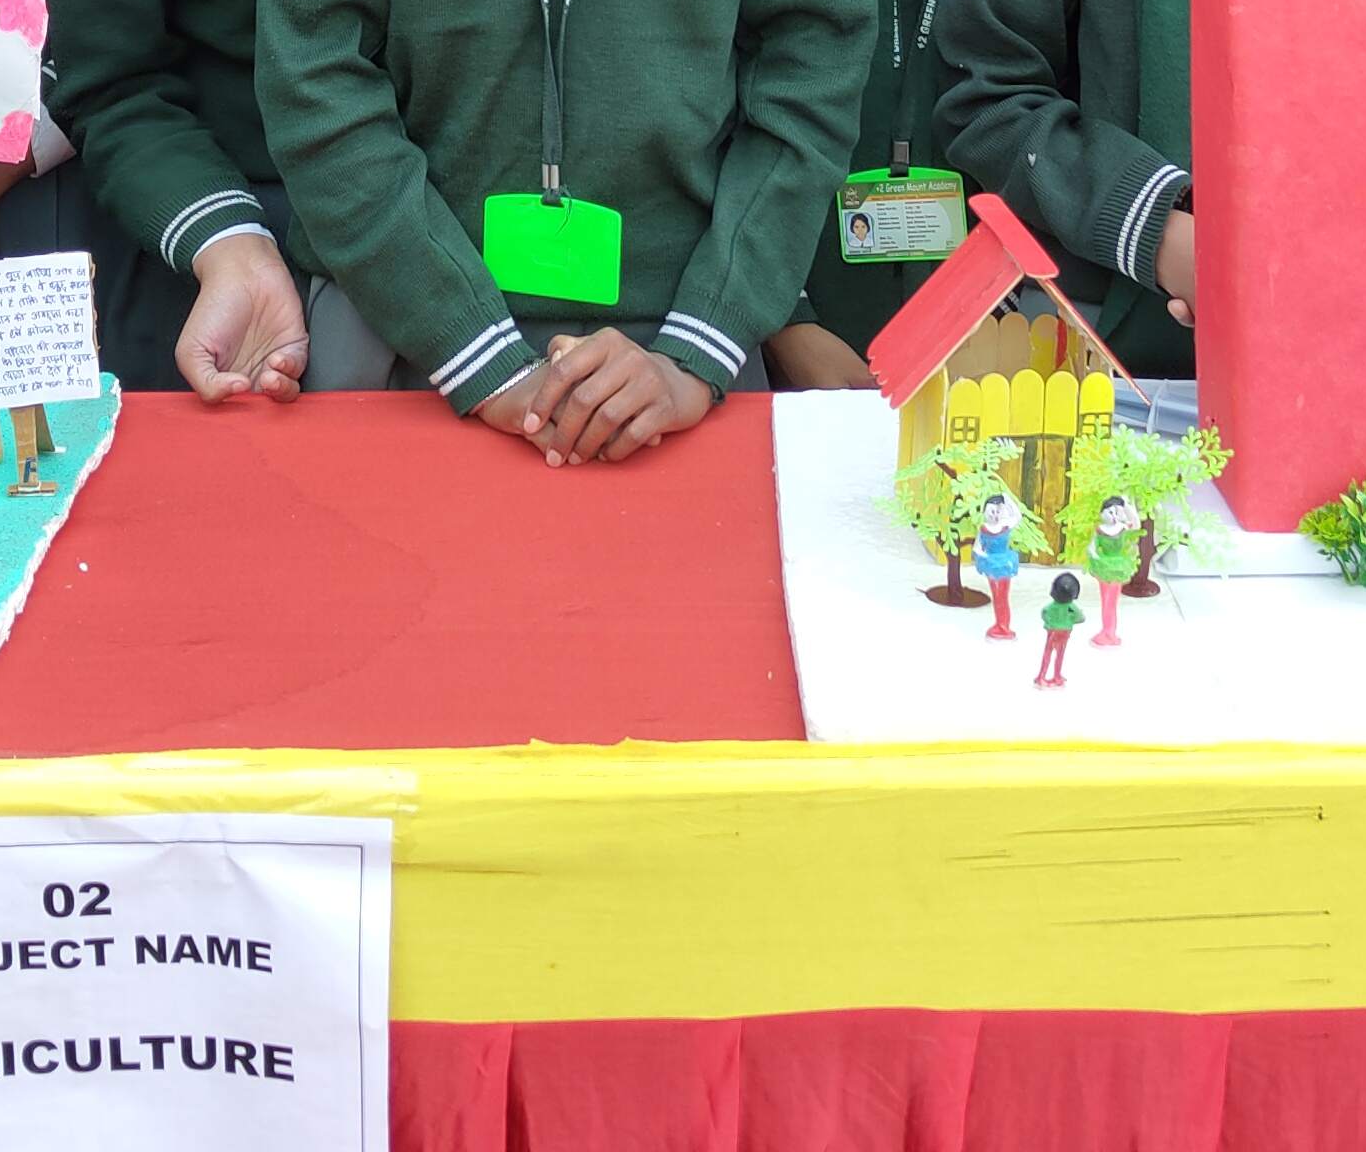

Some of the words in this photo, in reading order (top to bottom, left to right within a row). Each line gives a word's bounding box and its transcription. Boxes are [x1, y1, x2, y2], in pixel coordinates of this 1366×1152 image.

[886, 183, 905, 192] Green
[42, 881, 113, 919] 02
[135, 934, 274, 974] NAME
